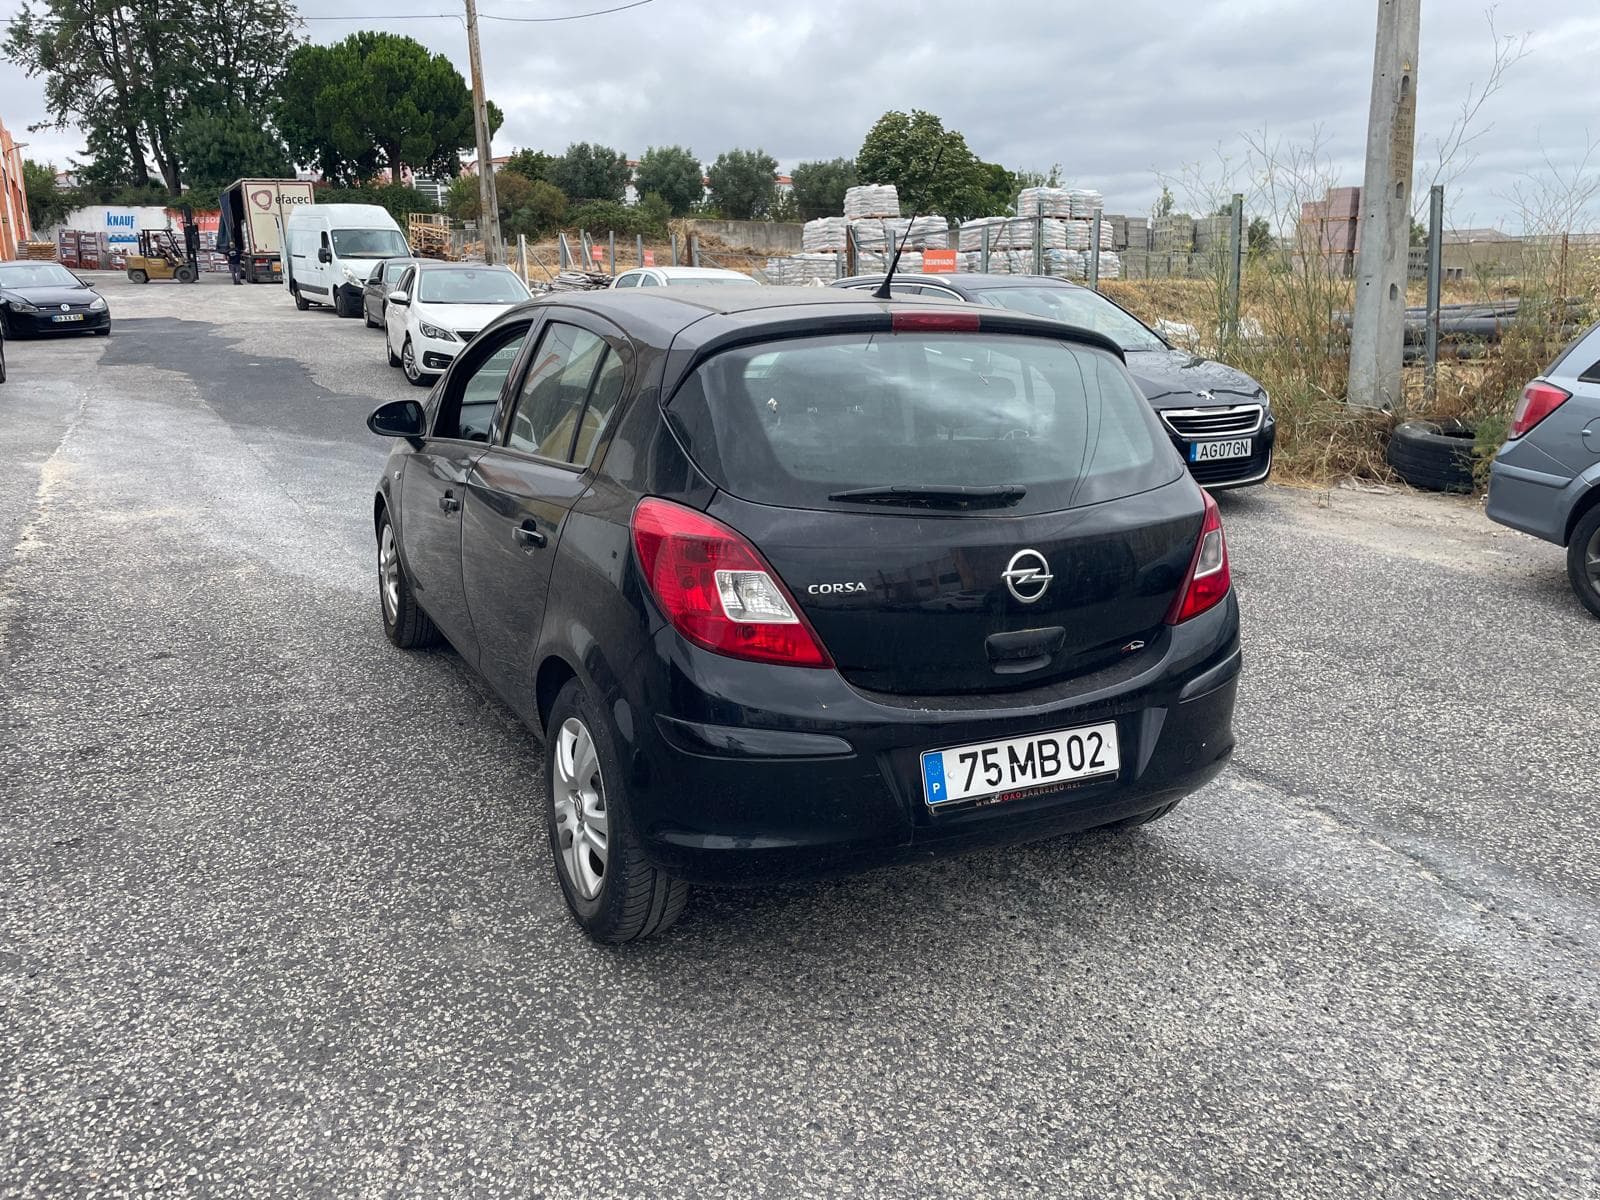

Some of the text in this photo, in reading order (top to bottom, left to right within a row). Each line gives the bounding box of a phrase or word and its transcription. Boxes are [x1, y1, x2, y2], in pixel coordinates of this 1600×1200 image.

[275, 194, 310, 205] efacec
[1199, 440, 1249, 459] AG07GN
[807, 581, 868, 595] CORSA
[932, 782, 941, 794] P
